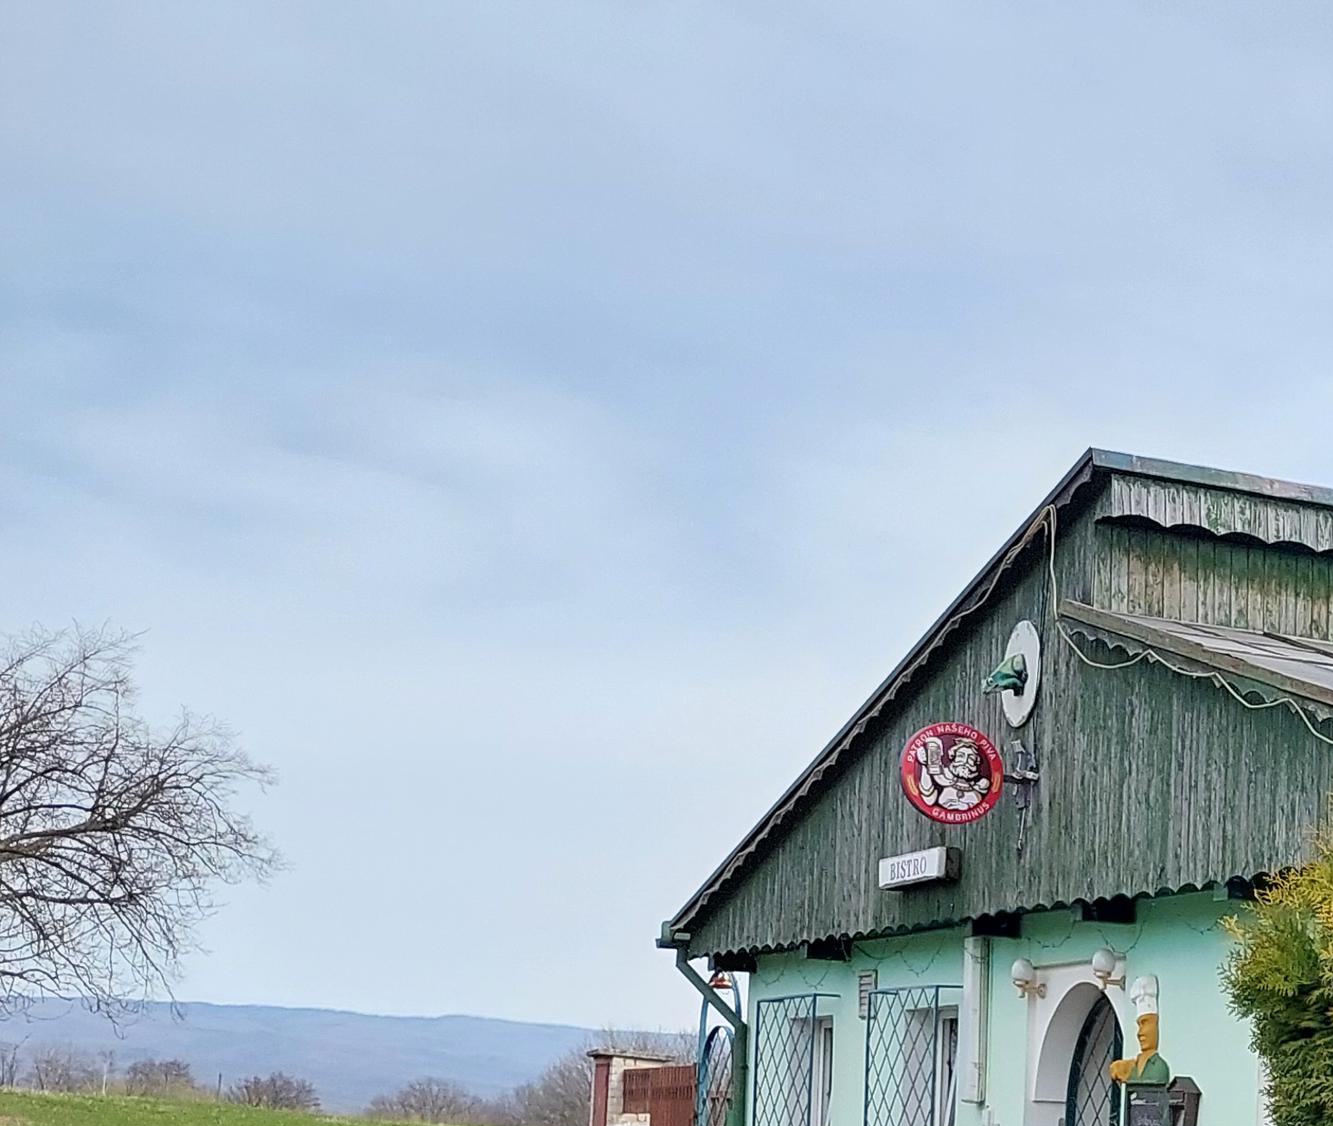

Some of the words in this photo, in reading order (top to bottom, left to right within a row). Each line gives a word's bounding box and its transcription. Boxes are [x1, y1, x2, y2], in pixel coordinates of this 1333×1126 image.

[907, 729, 934, 762] PATRON
[936, 723, 978, 738] NAŠEHO
[979, 739, 996, 760] PIVA
[932, 802, 990, 821] GAMBRINUS
[890, 856, 927, 880] BISTRO
